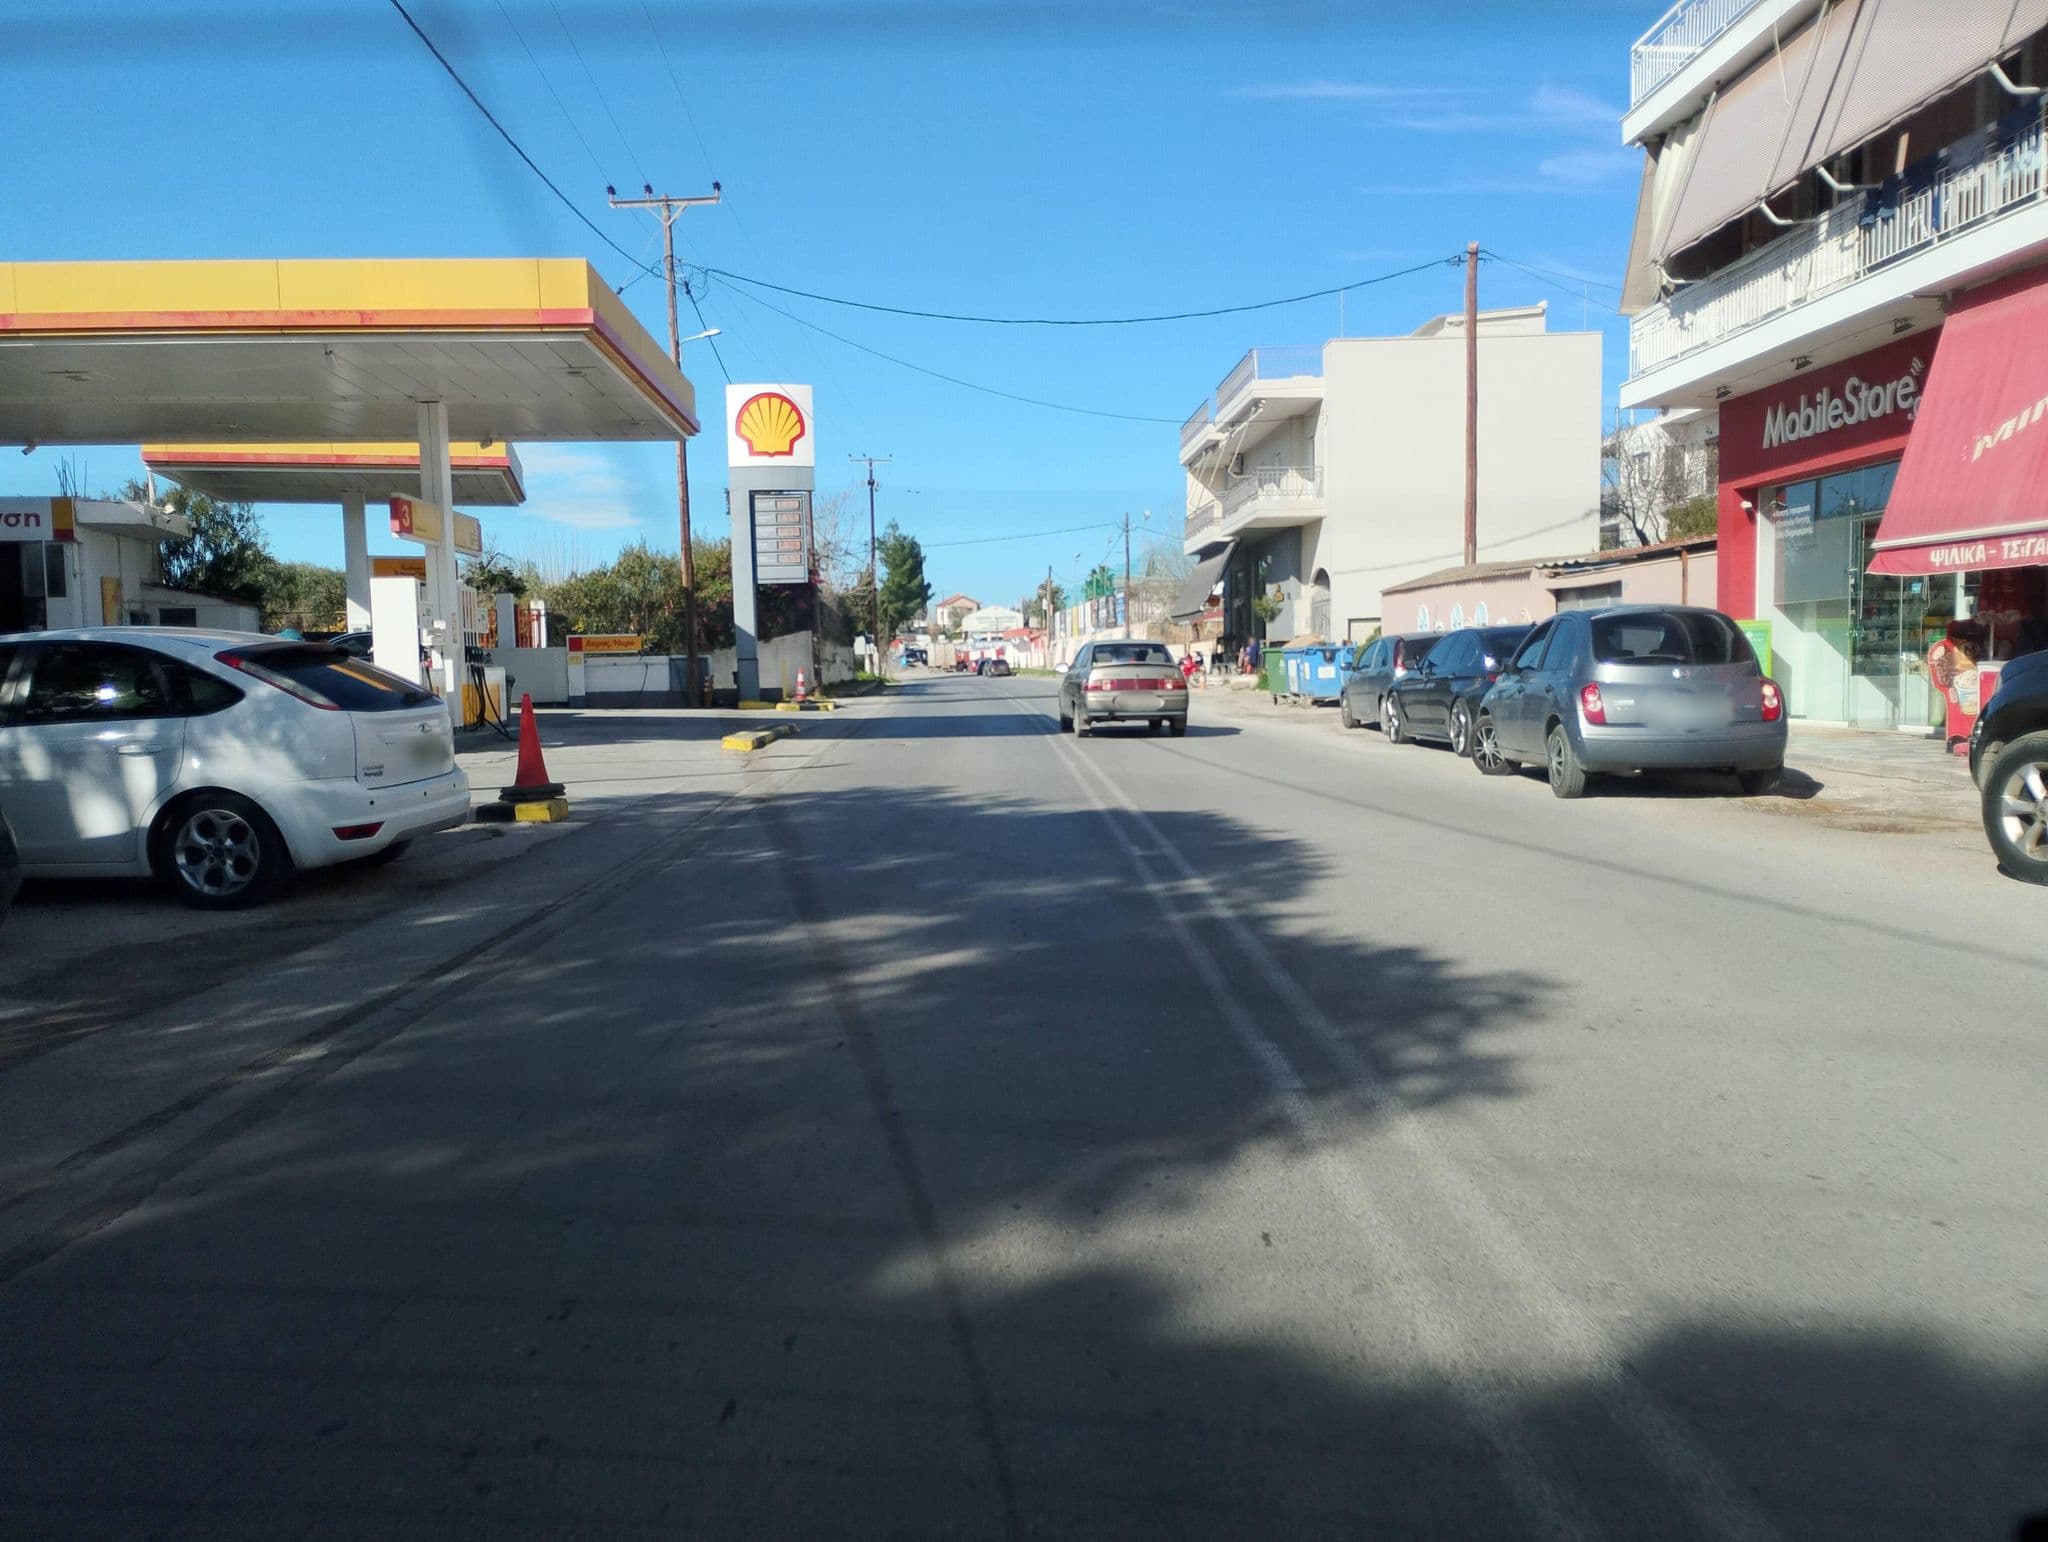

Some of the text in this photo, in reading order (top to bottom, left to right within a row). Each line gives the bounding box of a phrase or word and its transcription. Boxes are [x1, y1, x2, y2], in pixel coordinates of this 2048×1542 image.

[1763, 375, 1918, 448] MobileStore
[402, 505, 410, 527] 3
[1930, 543, 1986, 567] ΨΙΛΙΚΑ
[2001, 537, 2048, 560] ΤΣΙΓΑ
